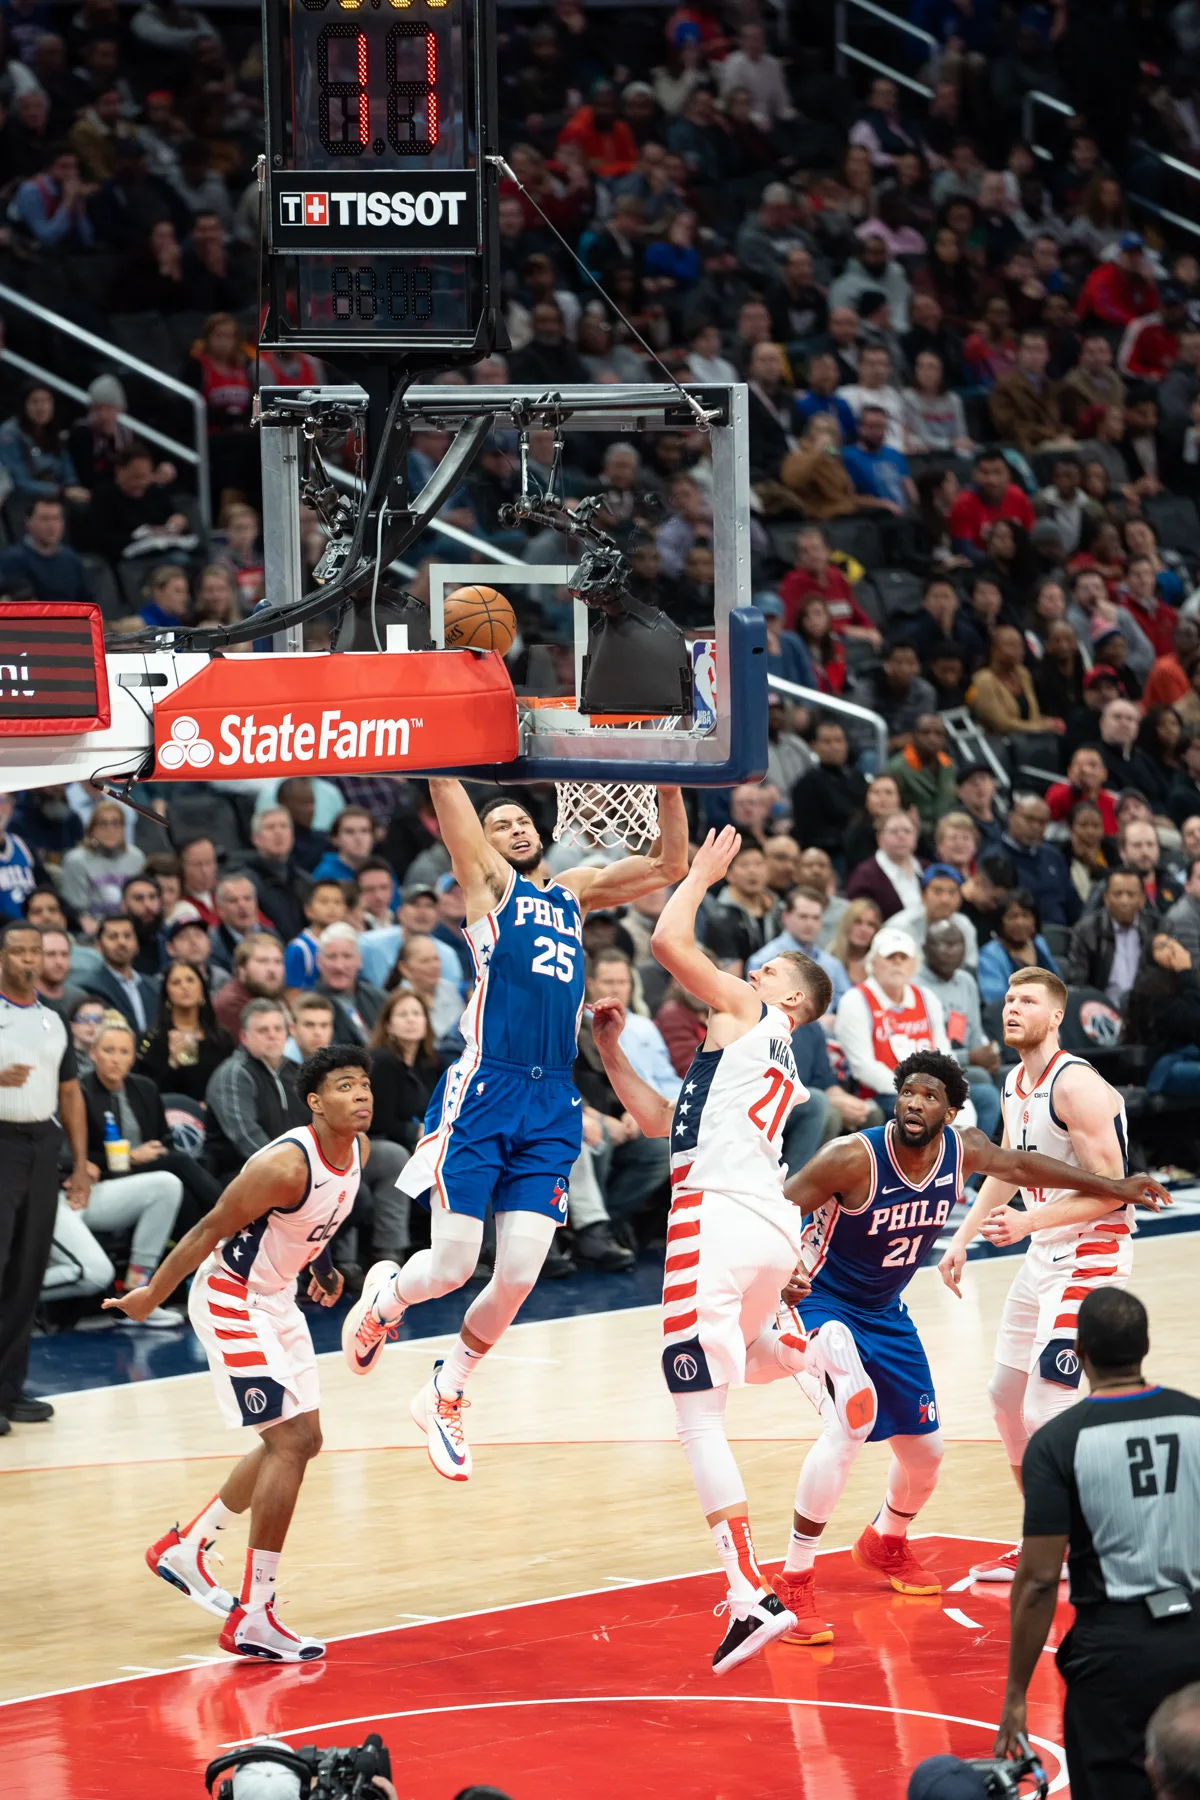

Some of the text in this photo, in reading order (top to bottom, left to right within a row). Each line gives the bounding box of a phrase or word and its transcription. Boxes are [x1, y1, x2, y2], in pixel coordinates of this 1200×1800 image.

[330, 191, 467, 227] TISSOT
[531, 935, 577, 984] 25
[747, 1066, 795, 1143] 21
[867, 1199, 950, 1236] PHILA
[881, 1234, 924, 1268] 21
[918, 1400, 937, 1425] 76
[1125, 1432, 1180, 1498] 27
